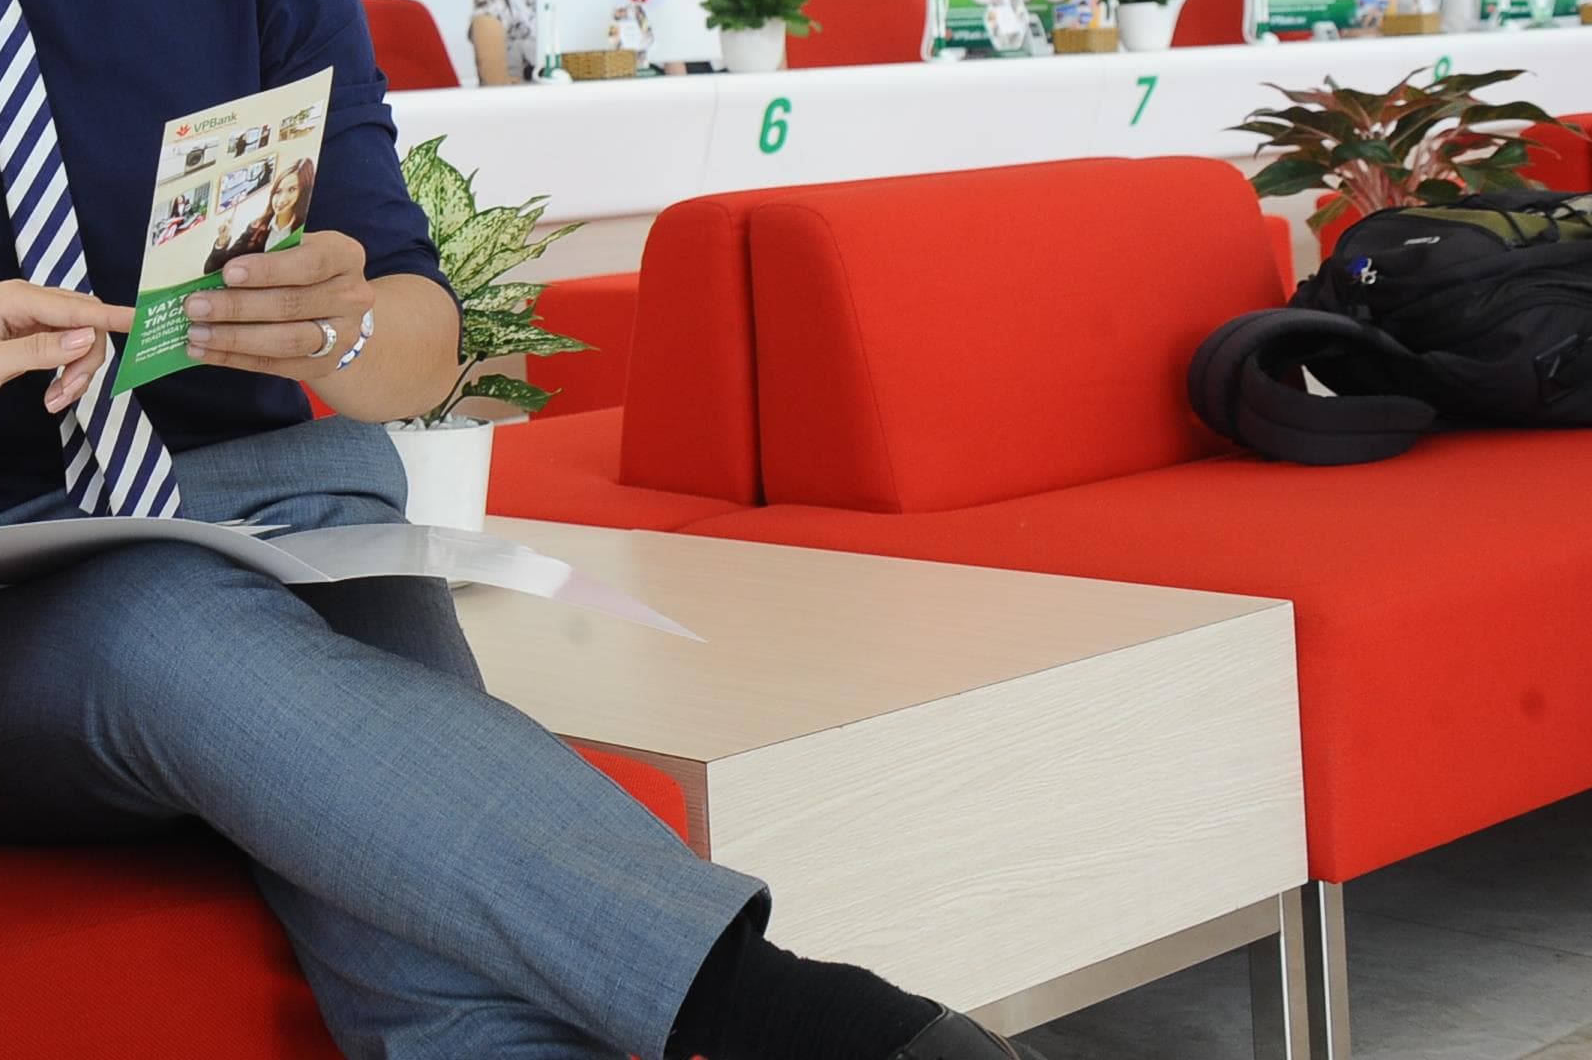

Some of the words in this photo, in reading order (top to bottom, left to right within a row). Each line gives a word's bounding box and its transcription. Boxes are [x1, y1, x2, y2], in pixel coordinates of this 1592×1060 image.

[194, 112, 238, 132] VPBank
[759, 96, 792, 155] 6
[1130, 76, 1158, 126] 7
